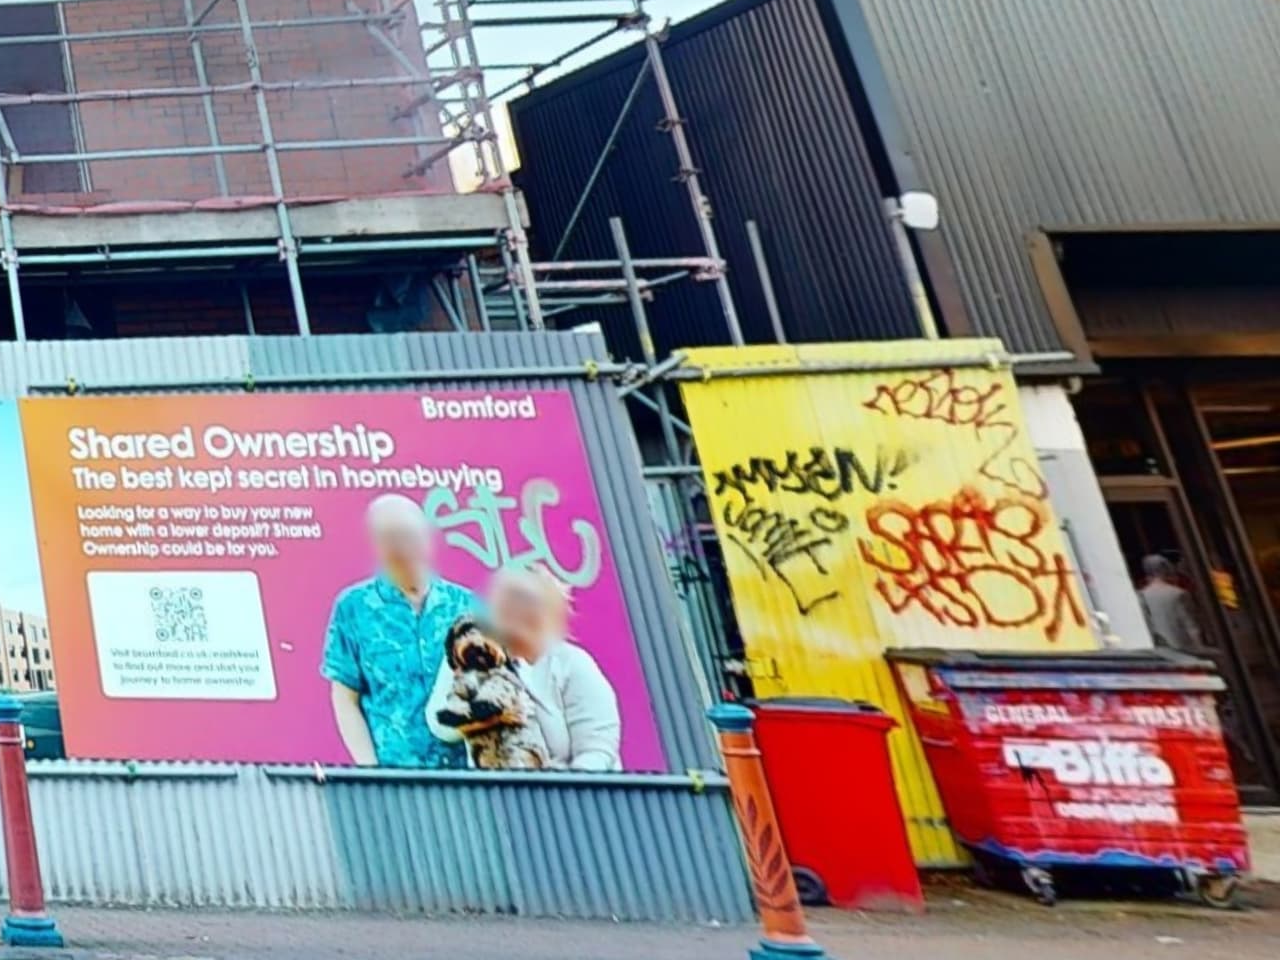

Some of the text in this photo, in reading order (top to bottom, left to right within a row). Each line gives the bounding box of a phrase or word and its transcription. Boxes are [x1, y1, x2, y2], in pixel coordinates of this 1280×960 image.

[421, 395, 536, 419] Bromford
[68, 424, 395, 463] Shared Ownership
[72, 463, 503, 493] The best kept secret in homebuying
[78, 505, 313, 522] Looking for a way to buy your new
[80, 523, 321, 539] home with a lower deposit? Shared
[83, 541, 279, 557] Ownership could be for you.
[985, 705, 1073, 726] GENERAL
